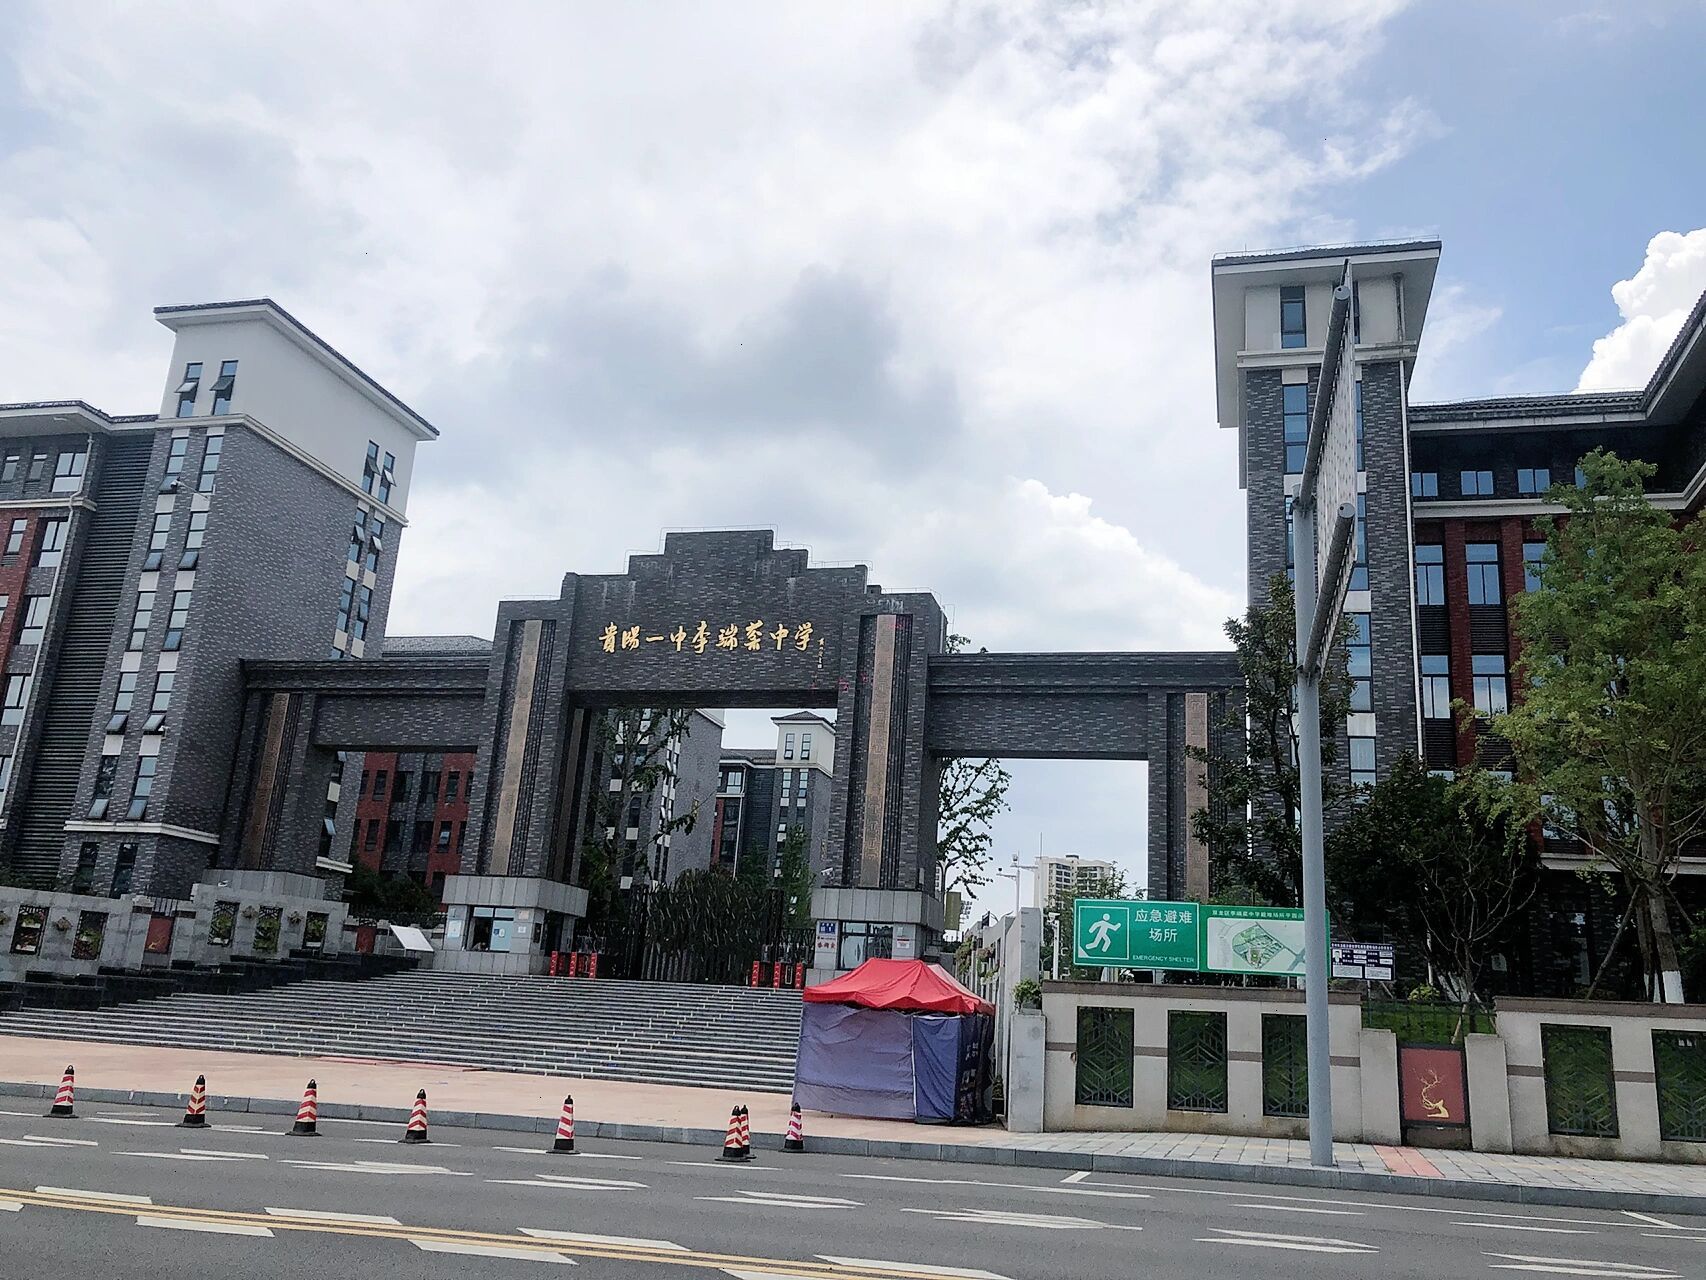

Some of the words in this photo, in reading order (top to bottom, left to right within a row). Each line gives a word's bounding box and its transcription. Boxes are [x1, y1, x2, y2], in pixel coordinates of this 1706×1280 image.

[1134, 908, 1193, 924] 应急避难
[1149, 928, 1177, 943] 场所
[1132, 954, 1168, 962] EMERGENCY
[1169, 955, 1195, 963] SHELTER
